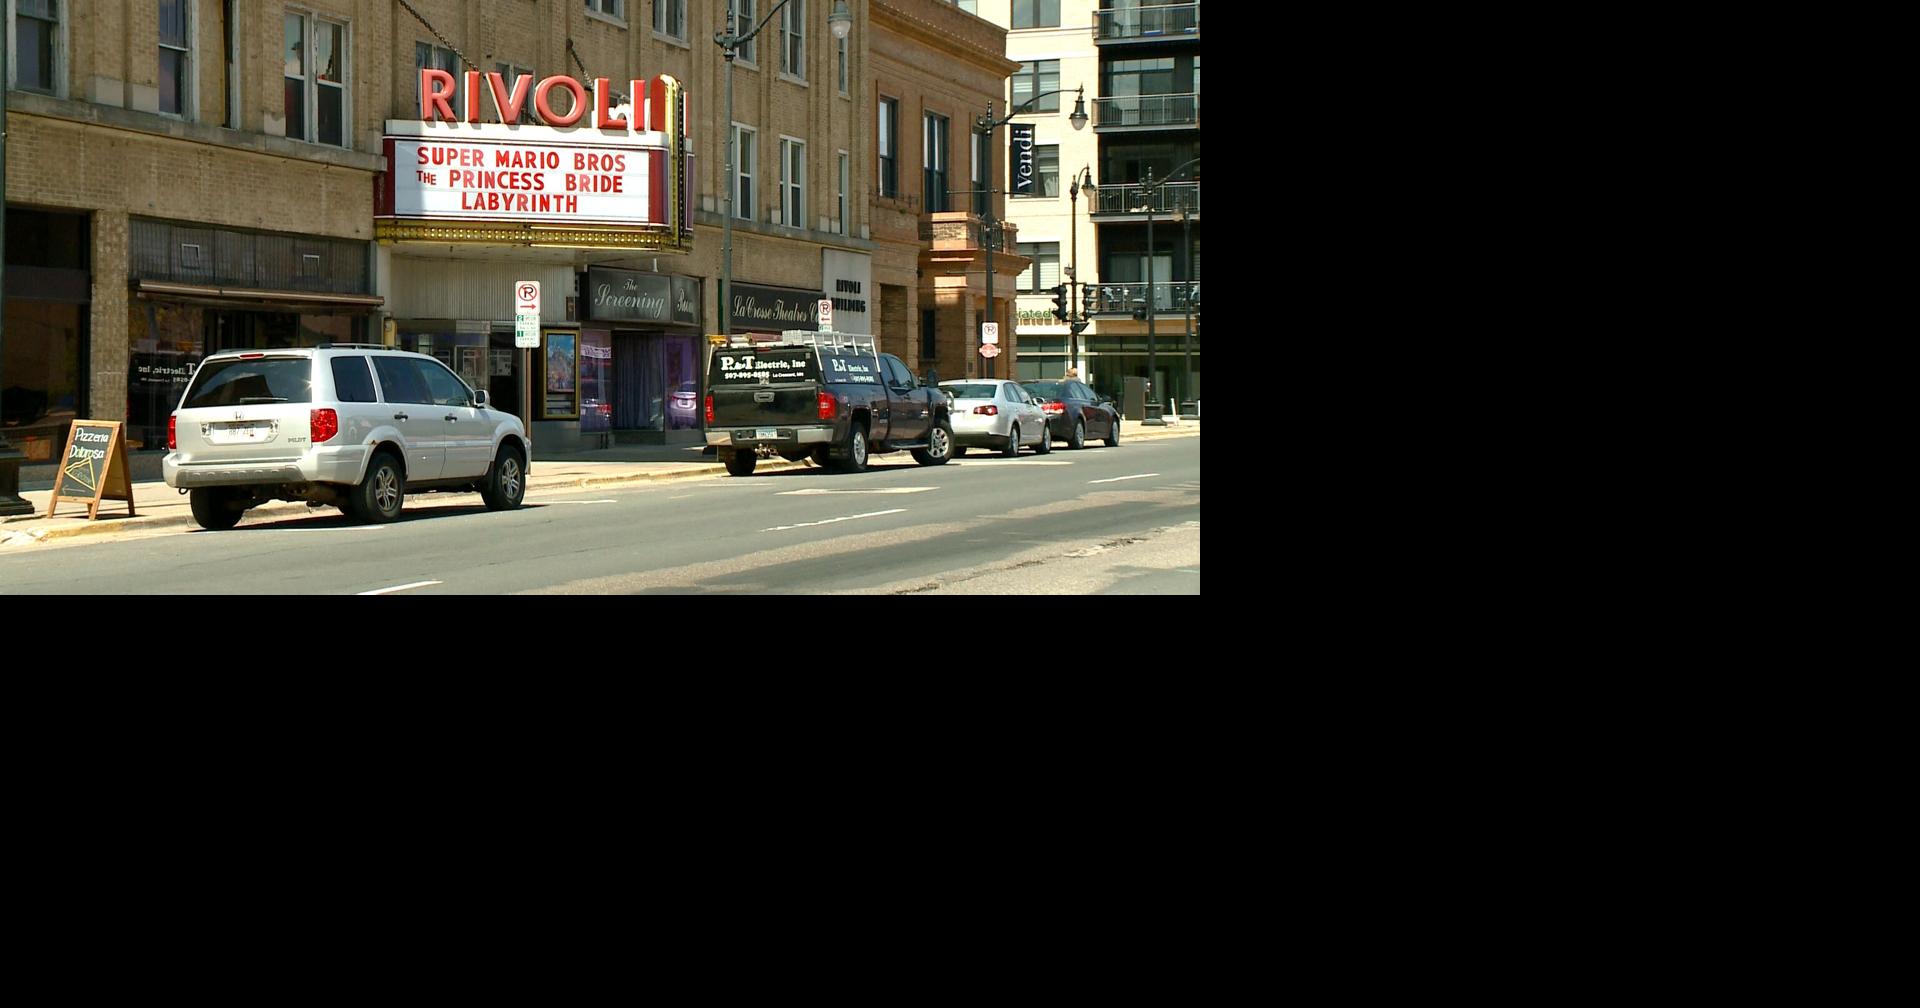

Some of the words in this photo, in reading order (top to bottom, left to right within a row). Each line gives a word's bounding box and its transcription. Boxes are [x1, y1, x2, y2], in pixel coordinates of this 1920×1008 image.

[420, 68, 646, 132] RIVOLI
[416, 146, 485, 168] SUPER
[495, 150, 560, 170] MARIO
[573, 153, 626, 172] BROS
[1013, 128, 1033, 190] vendi
[416, 170, 437, 186] THE
[448, 169, 545, 191] PRINCESS
[565, 173, 624, 193] BRIDE
[461, 192, 578, 214] LABYRINTH
[623, 279, 638, 291] The
[836, 279, 861, 295] RIVOLI
[594, 284, 665, 319] Screening
[732, 295, 746, 318] La
[746, 296, 772, 320] Crosse
[772, 299, 807, 323] Theatres
[1018, 308, 1052, 320] iated
[755, 360, 790, 369] Electric,
[791, 360, 806, 368] Inc
[75, 427, 109, 443] Pizzeria
[68, 444, 105, 460] Dolorosa
